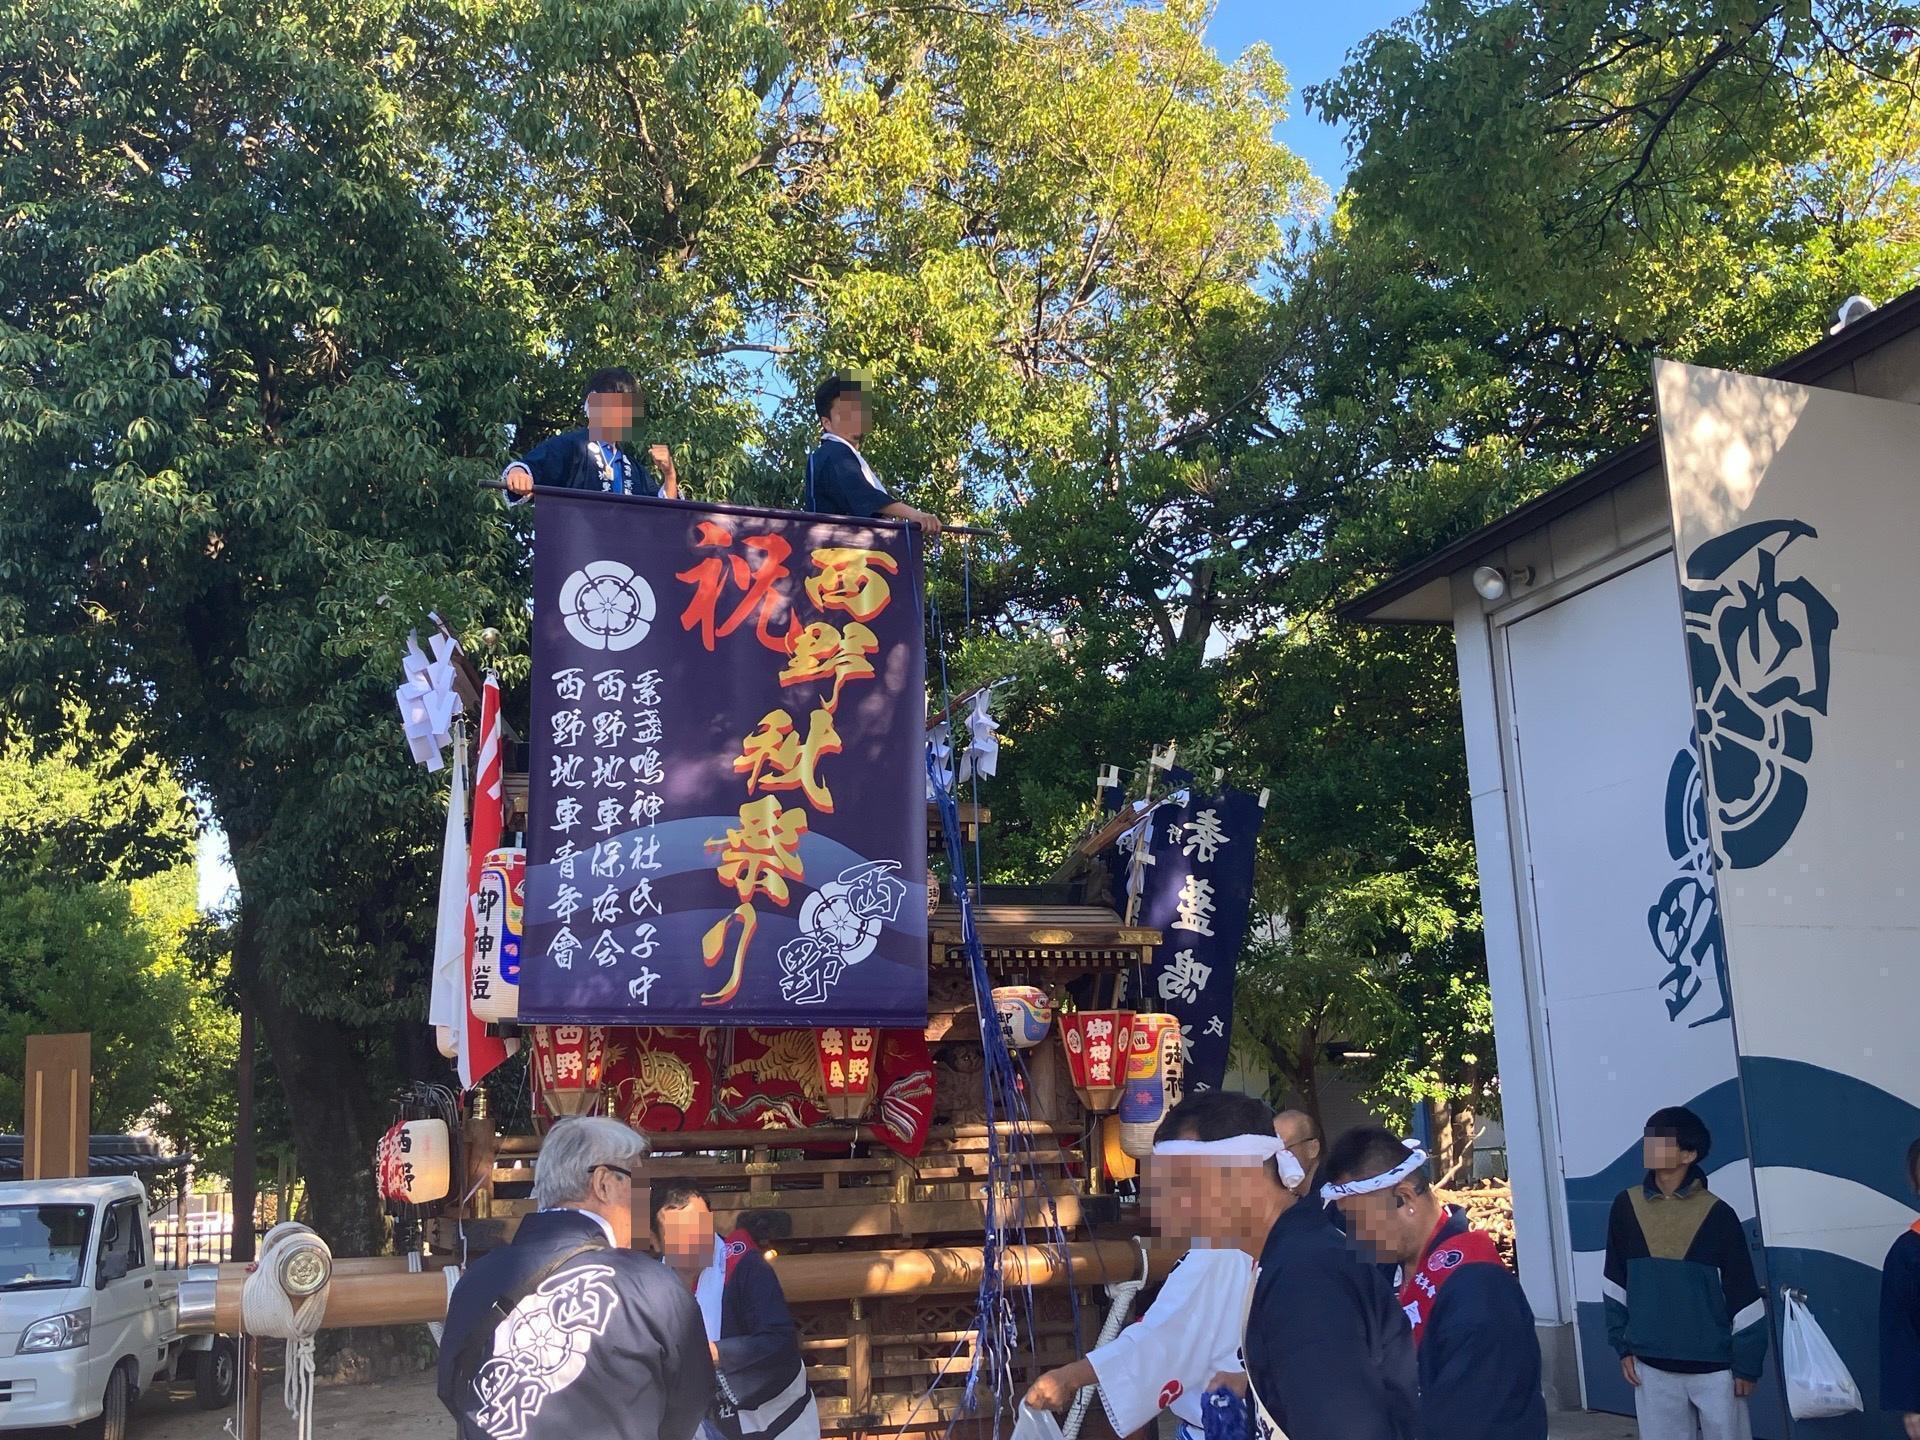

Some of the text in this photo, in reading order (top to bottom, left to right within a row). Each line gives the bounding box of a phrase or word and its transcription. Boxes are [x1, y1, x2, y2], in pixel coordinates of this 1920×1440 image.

[676, 521, 803, 655] 祝
[588, 667, 627, 969] 西野地車保存会
[701, 548, 898, 1006] 西野秋祭り
[555, 1026, 583, 1080] 西野
[848, 1027, 873, 1085] 西野
[1086, 1018, 1113, 1081] 御神燈
